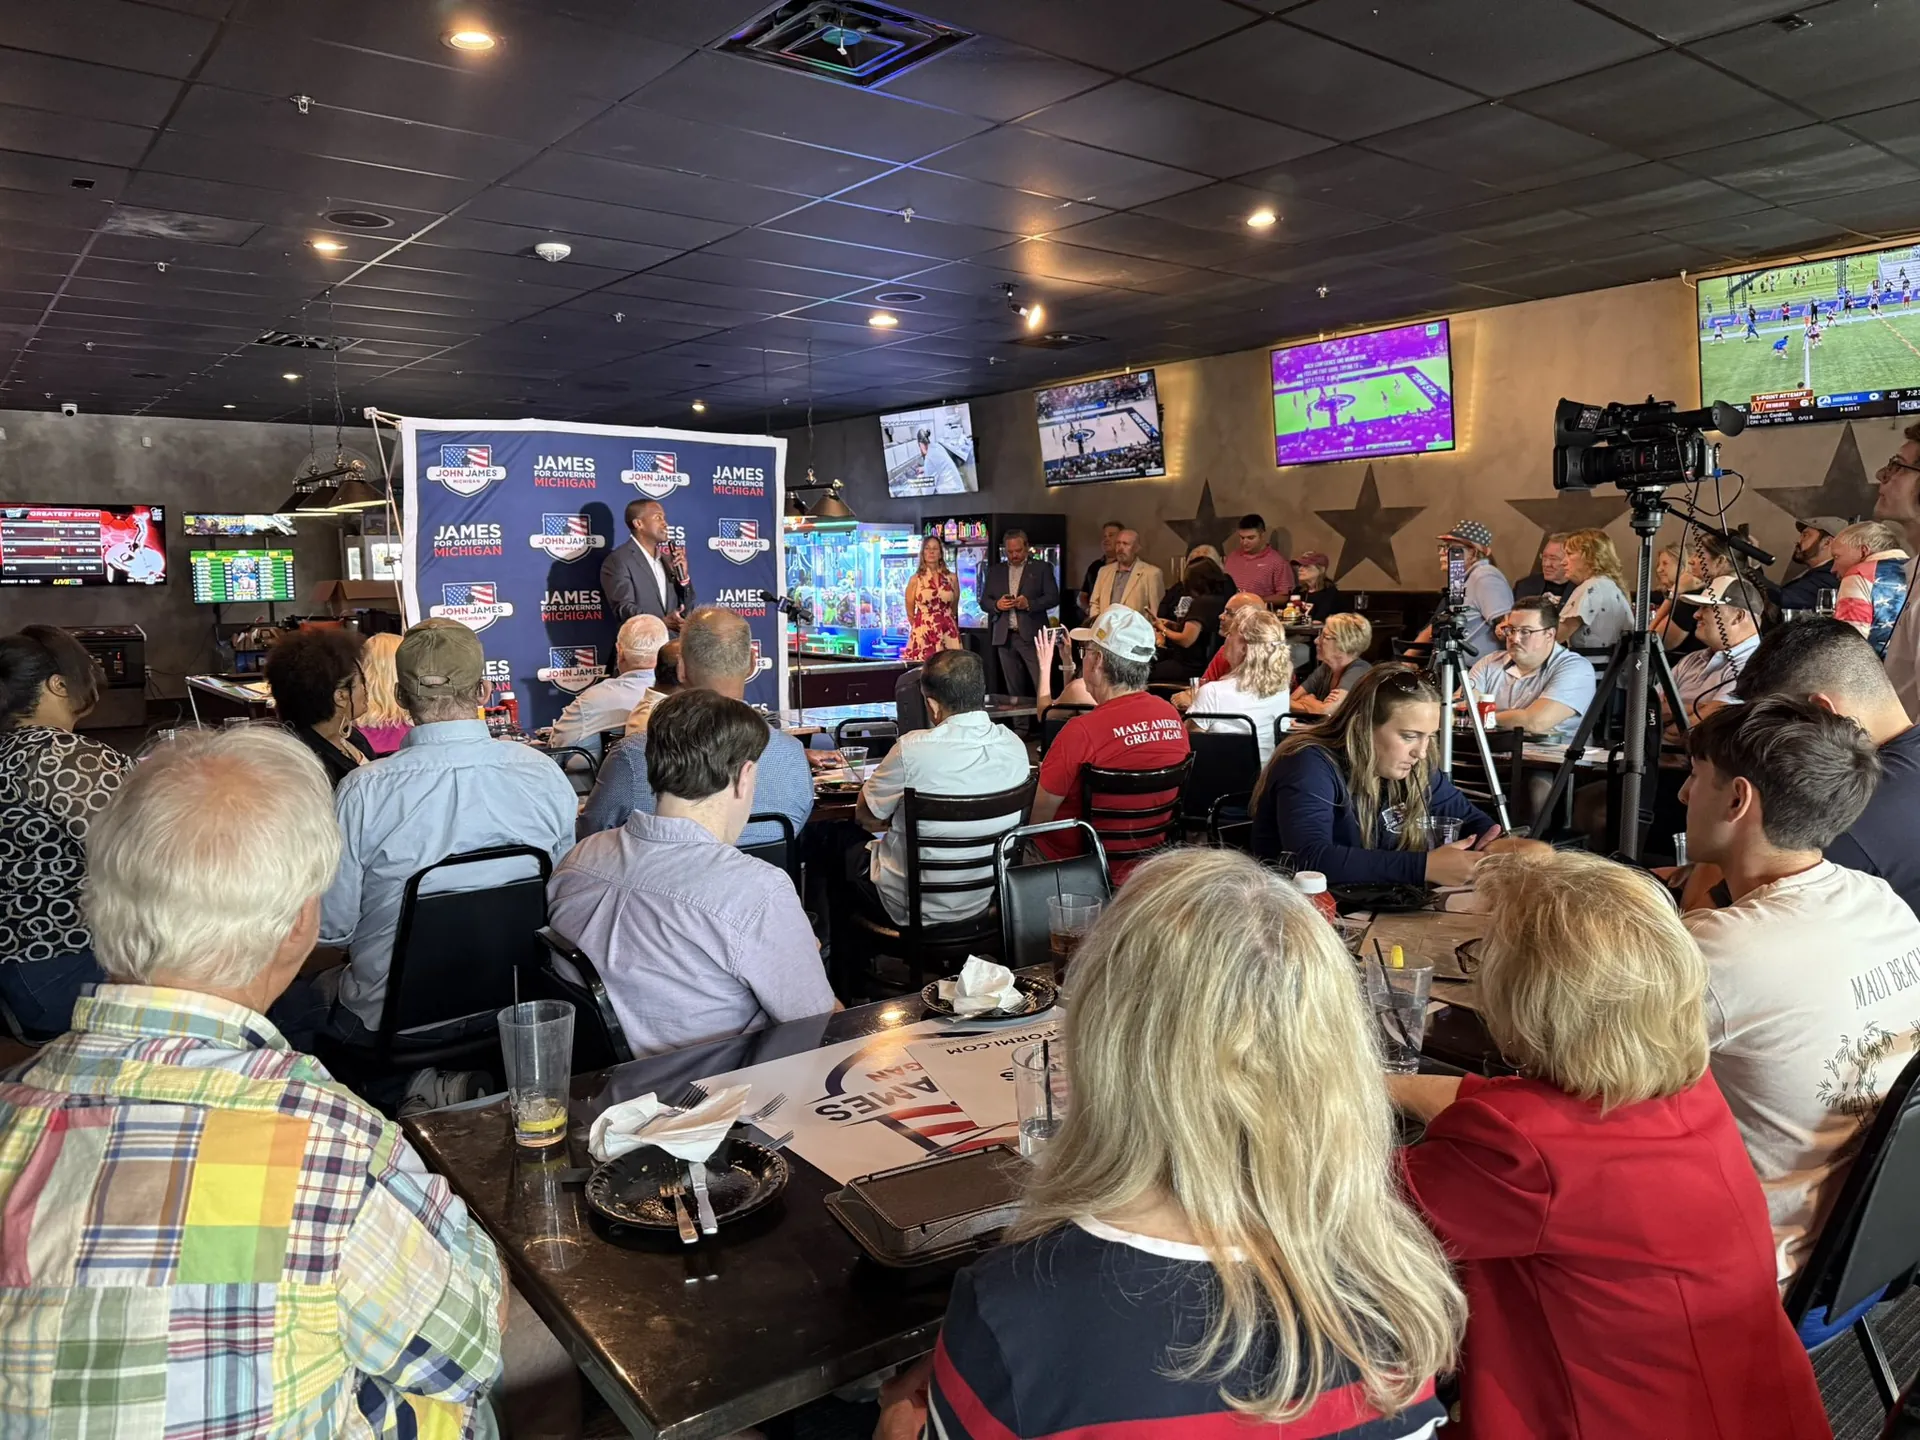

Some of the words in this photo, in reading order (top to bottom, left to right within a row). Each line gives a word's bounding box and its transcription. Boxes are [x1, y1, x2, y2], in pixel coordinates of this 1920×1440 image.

[1869, 392, 1879, 401] 0
[1800, 399, 1809, 407] 6
[533, 455, 596, 472] JAMES
[436, 469, 464, 478] JOHN
[465, 469, 497, 477] JAMES
[534, 470, 552, 478] FOR
[552, 471, 596, 479] GOVERNOR
[629, 473, 654, 481] JOHN
[655, 474, 682, 482] JAMES
[712, 465, 764, 480] JAMES
[534, 477, 596, 489] MICHIGAN
[713, 486, 764, 497] MICHIGAN
[434, 523, 501, 540] JAMES
[434, 540, 453, 548] FOR
[454, 538, 501, 547] GOVERNOR
[538, 537, 565, 545] JOHN
[566, 537, 597, 545] JAMES
[434, 545, 502, 557] MICHIGAN
[540, 590, 601, 605] JAMES
[716, 588, 764, 602] JAMES
[440, 607, 469, 616] JOHN
[470, 605, 504, 614] JAMES
[541, 604, 558, 612] FOR
[559, 603, 602, 611] GOVERNOR
[541, 611, 602, 622] MICHIGAN
[546, 670, 572, 679] JOHN
[573, 667, 603, 676] JAMES
[1113, 721, 1150, 738] MAKE
[1124, 731, 1160, 746] GREAT
[1850, 966, 1892, 1010] MAUI
